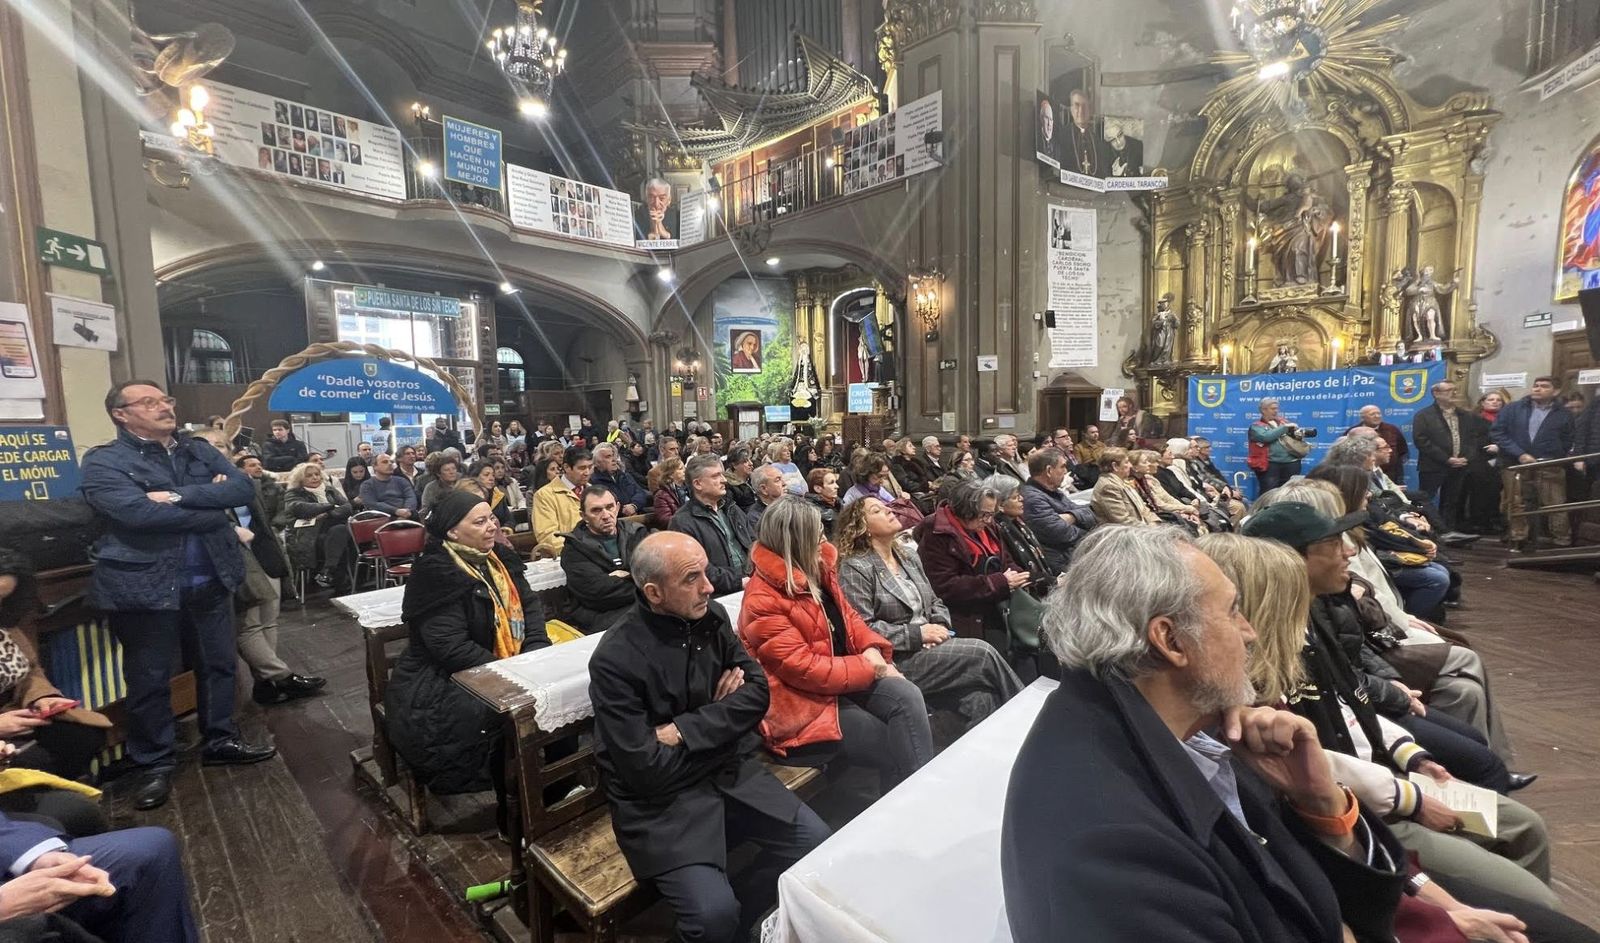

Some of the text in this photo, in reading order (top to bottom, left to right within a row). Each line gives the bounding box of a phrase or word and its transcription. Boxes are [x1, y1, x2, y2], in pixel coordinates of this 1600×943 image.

[447, 121, 490, 139] MUJERES
[450, 132, 495, 150] HOMBRES
[463, 145, 483, 155] QUE
[450, 150, 496, 168] HACEN UN
[457, 161, 490, 175] MUNDO
[458, 170, 488, 184] MEJOR
[1107, 181, 1136, 189] CARDENAL
[367, 290, 390, 306] PUERTA
[391, 293, 411, 309] SANTA
[411, 296, 419, 310] DE
[420, 297, 431, 311] LOS
[367, 380, 420, 389] vosotros
[1255, 379, 1320, 392] Mensajeros
[1324, 377, 1339, 388] de
[1353, 374, 1375, 385] Paz
[299, 387, 316, 397] de
[373, 389, 399, 400] dice
[401, 391, 436, 402] Jesús.
[0, 431, 47, 449] AQUÍ SE
[23, 450, 71, 463] CARGAR
[2, 465, 60, 481] EL MÓVIL
